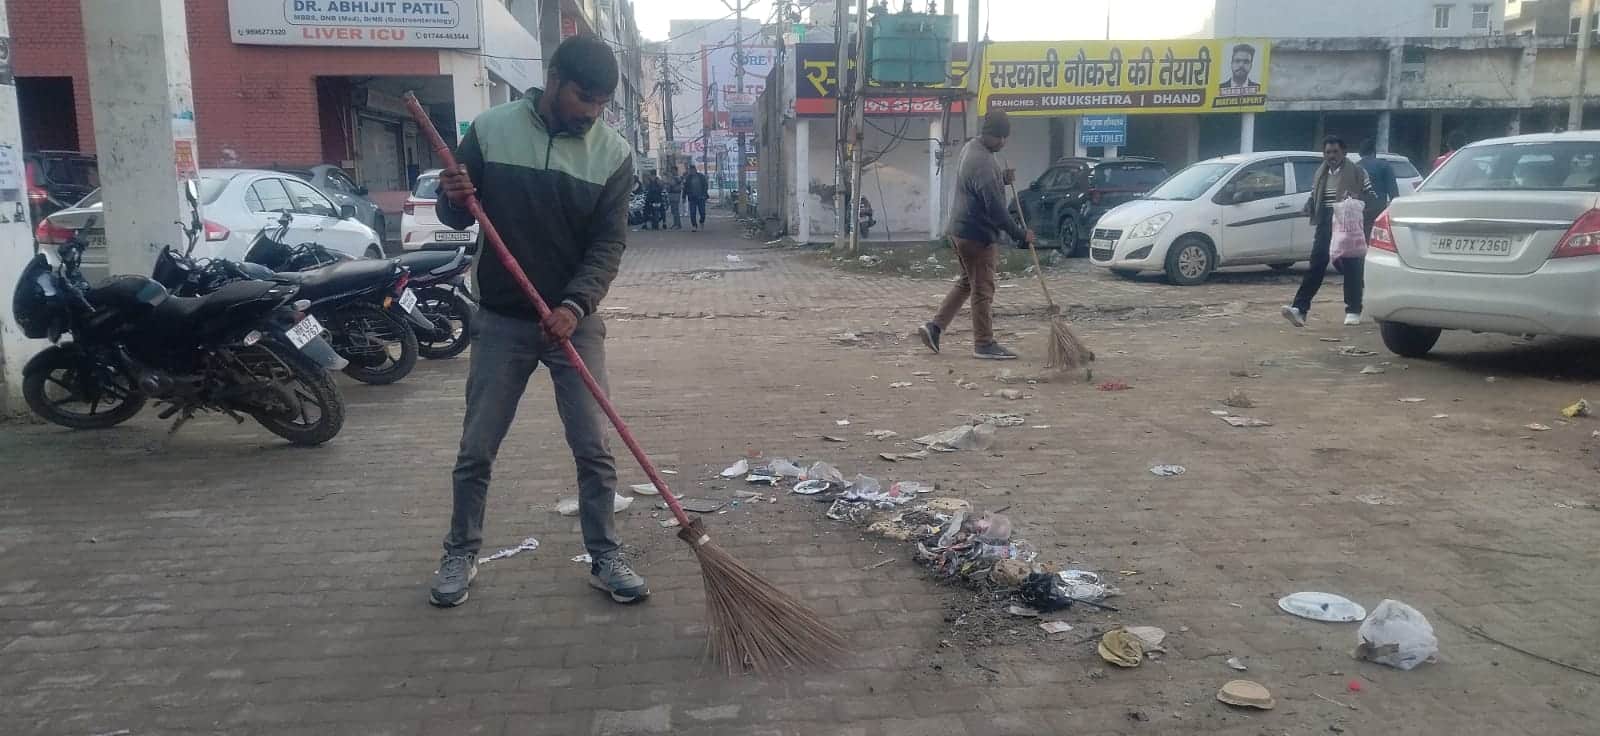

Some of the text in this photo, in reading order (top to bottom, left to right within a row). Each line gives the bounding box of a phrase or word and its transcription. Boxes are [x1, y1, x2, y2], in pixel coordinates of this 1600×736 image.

[294, 0, 450, 15] DR. ABHIJIT PATIL
[302, 27, 363, 40] LIVER
[369, 28, 406, 41] ICU
[990, 47, 1060, 89] सरकारी
[1064, 46, 1123, 87] नौकरी
[1127, 46, 1155, 86] की
[1158, 46, 1212, 86] तैयारी
[1041, 95, 1132, 107] KURUKSHETRA
[1153, 93, 1201, 105] DHAND
[1081, 134, 1124, 144] FREE TOILET
[1438, 238, 1453, 249] HR
